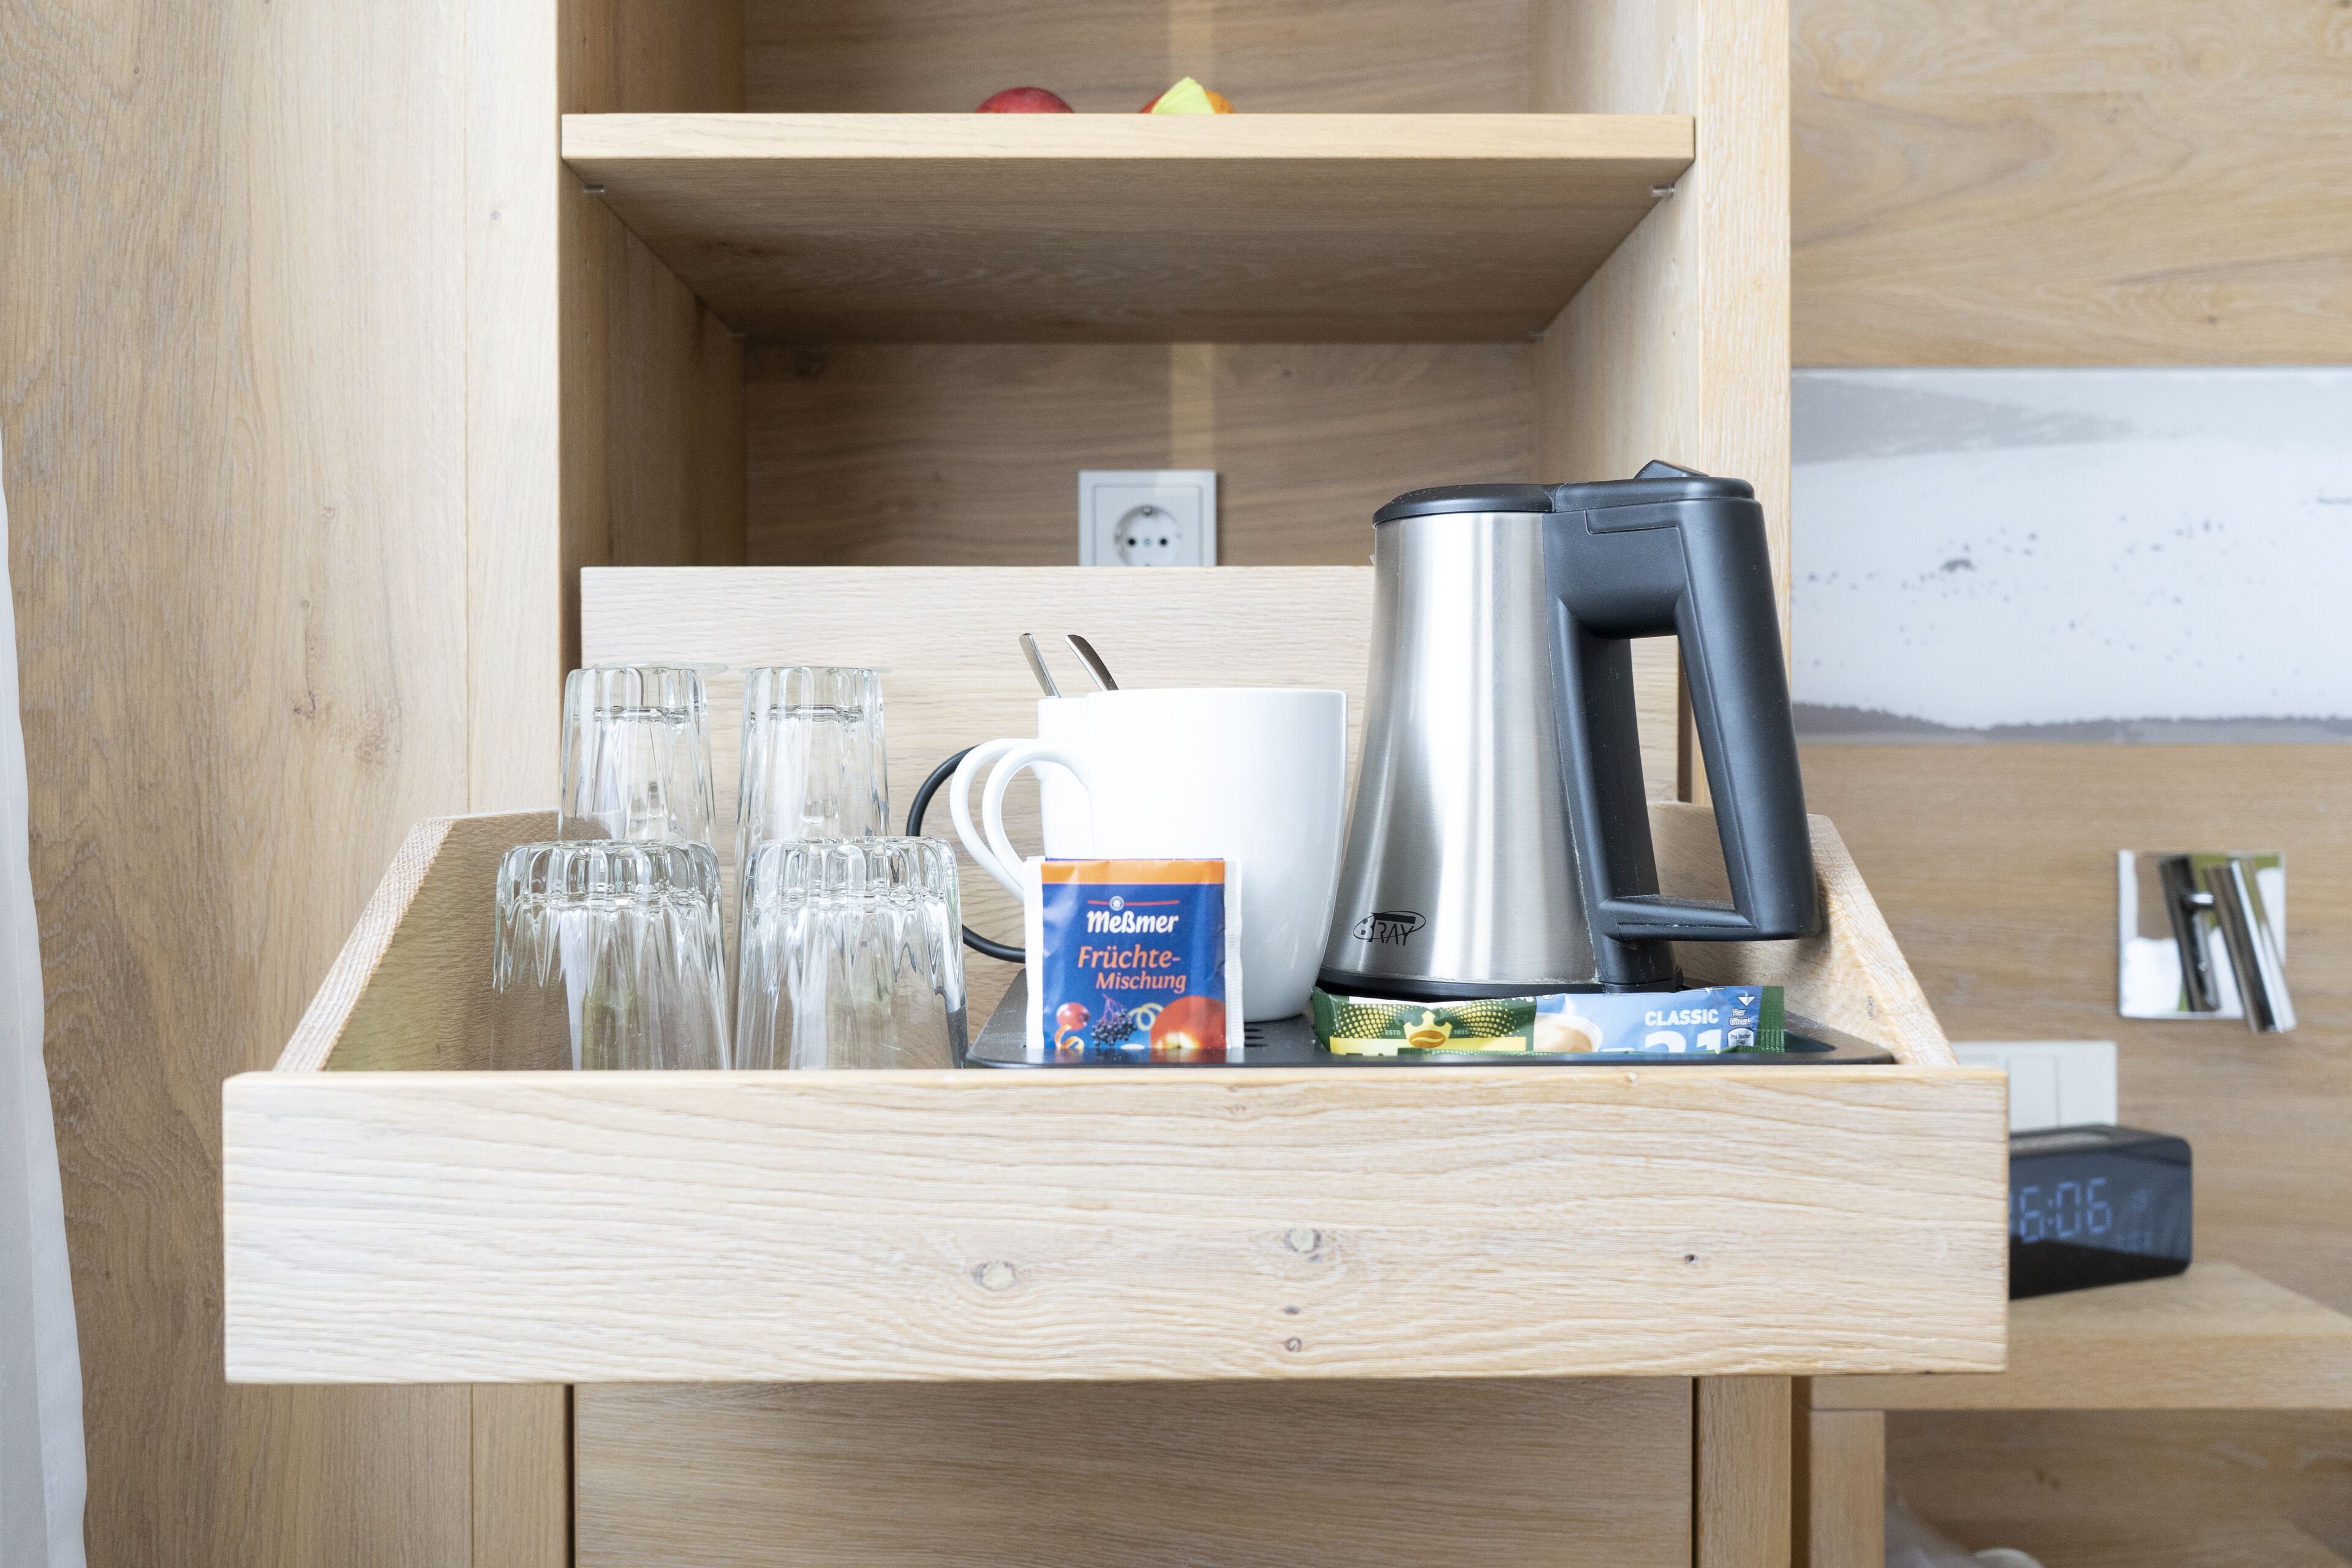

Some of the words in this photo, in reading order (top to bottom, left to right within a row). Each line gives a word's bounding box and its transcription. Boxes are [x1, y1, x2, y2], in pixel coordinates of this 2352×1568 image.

[1087, 910, 1179, 933] Meßmer
[1078, 943, 1181, 968] Früchte-
[1095, 971, 1186, 993] Mischung
[1645, 1009, 1719, 1027] CLASSIC
